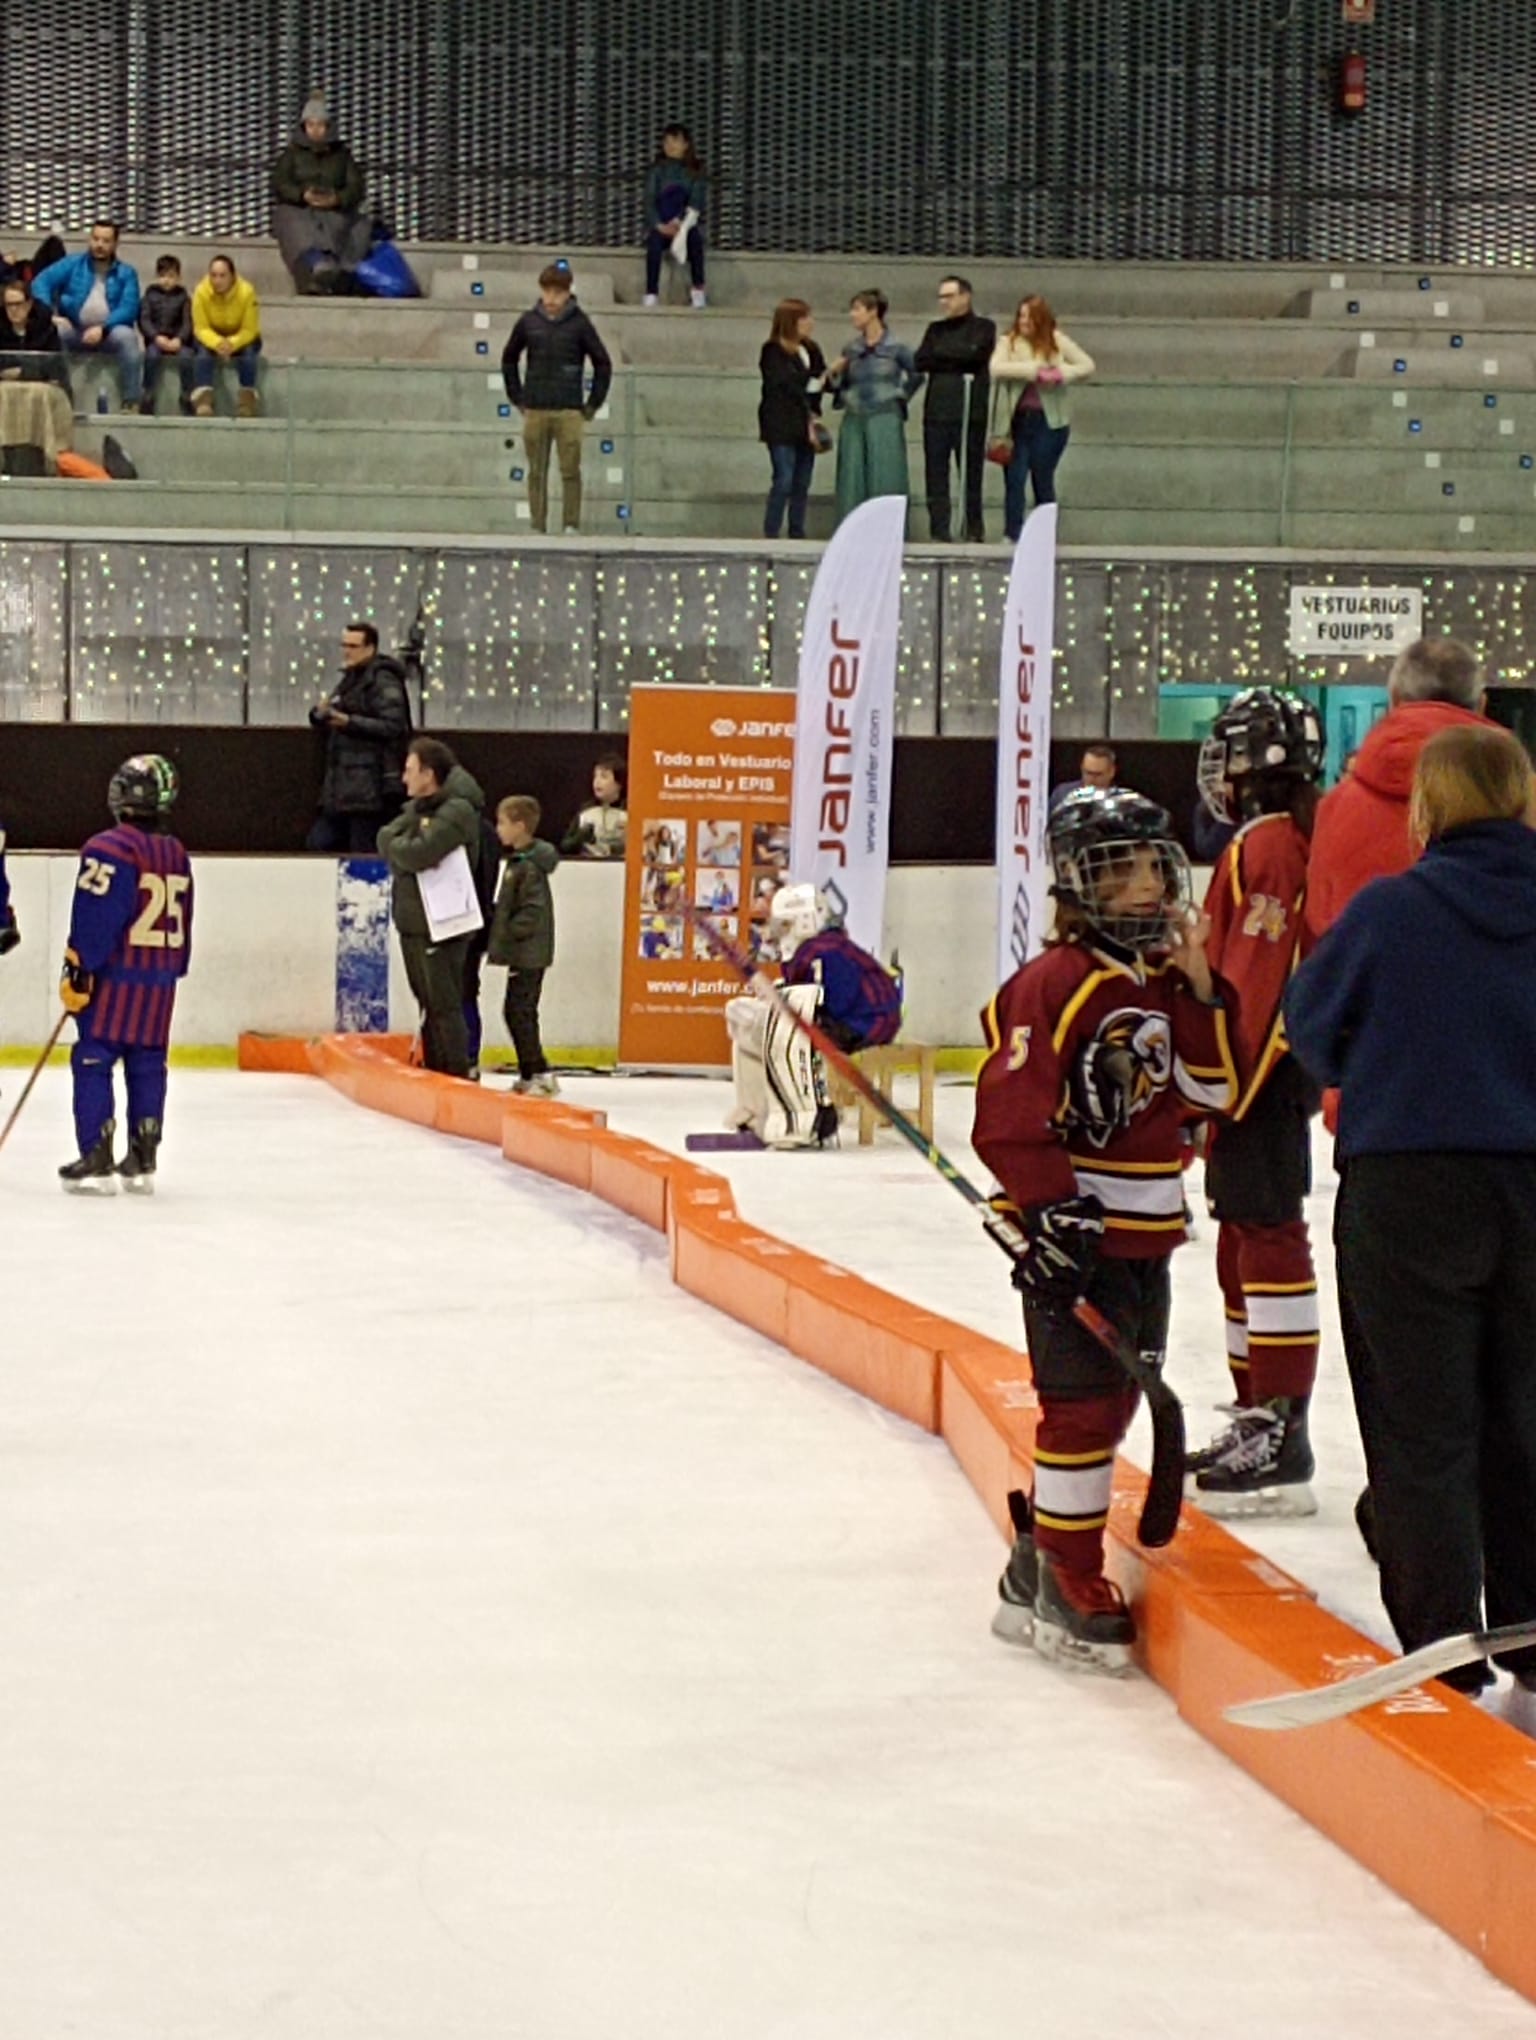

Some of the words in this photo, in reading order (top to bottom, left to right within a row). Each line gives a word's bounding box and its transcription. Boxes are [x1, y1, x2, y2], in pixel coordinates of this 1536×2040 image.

[1302, 596, 1411, 614] VESTUARIOS
[1318, 622, 1394, 641] EQUIPOS
[653, 750, 693, 766] Todo
[696, 756, 715, 766] en
[720, 754, 792, 769] Vestuario
[664, 774, 722, 790] Laboral
[726, 780, 735, 792] y
[739, 776, 775, 792] EPIS
[79, 858, 115, 895] 25
[130, 873, 189, 948] 25
[1007, 1025, 1032, 1071] 5
